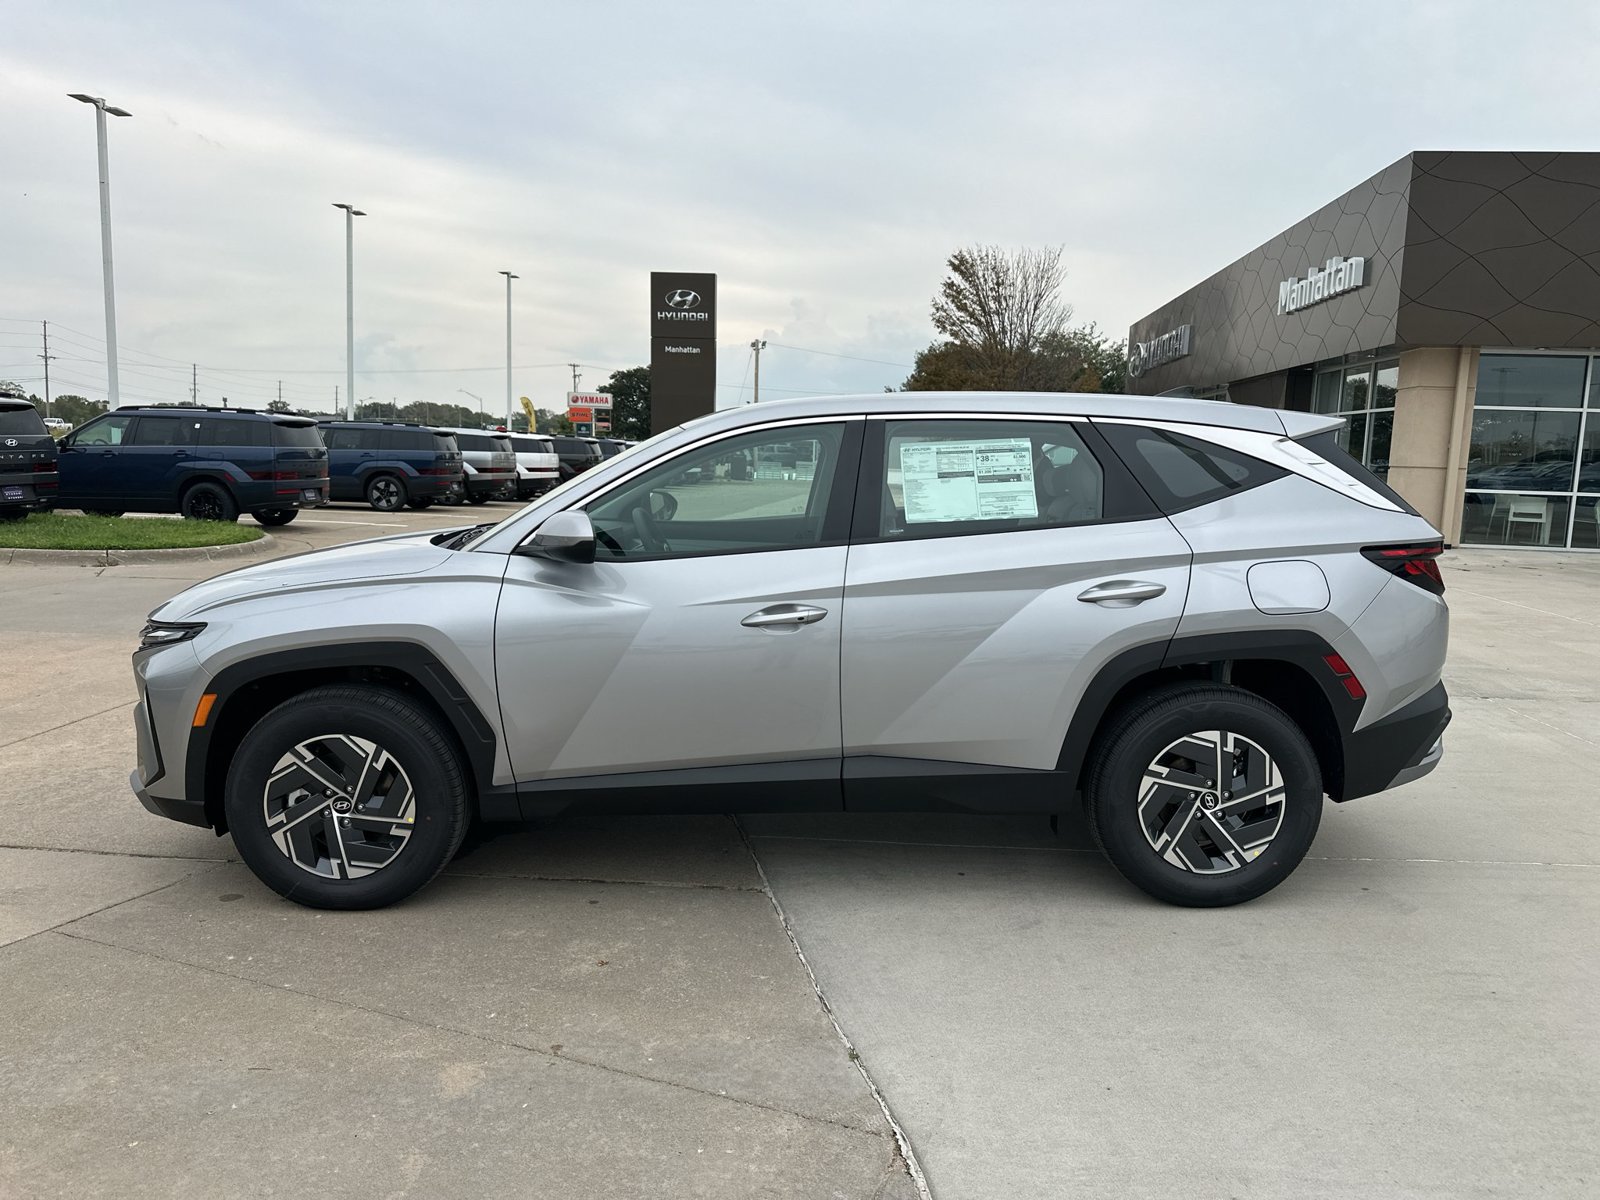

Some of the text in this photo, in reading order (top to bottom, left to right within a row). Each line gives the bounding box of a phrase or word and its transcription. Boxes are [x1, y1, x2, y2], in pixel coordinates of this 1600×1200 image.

[1277, 256, 1364, 315] Manhattan
[657, 311, 708, 321] HYUNDAI
[664, 345, 701, 354] Manhattan
[580, 396, 609, 404] YAMAHA
[980, 455, 990, 463] 38
